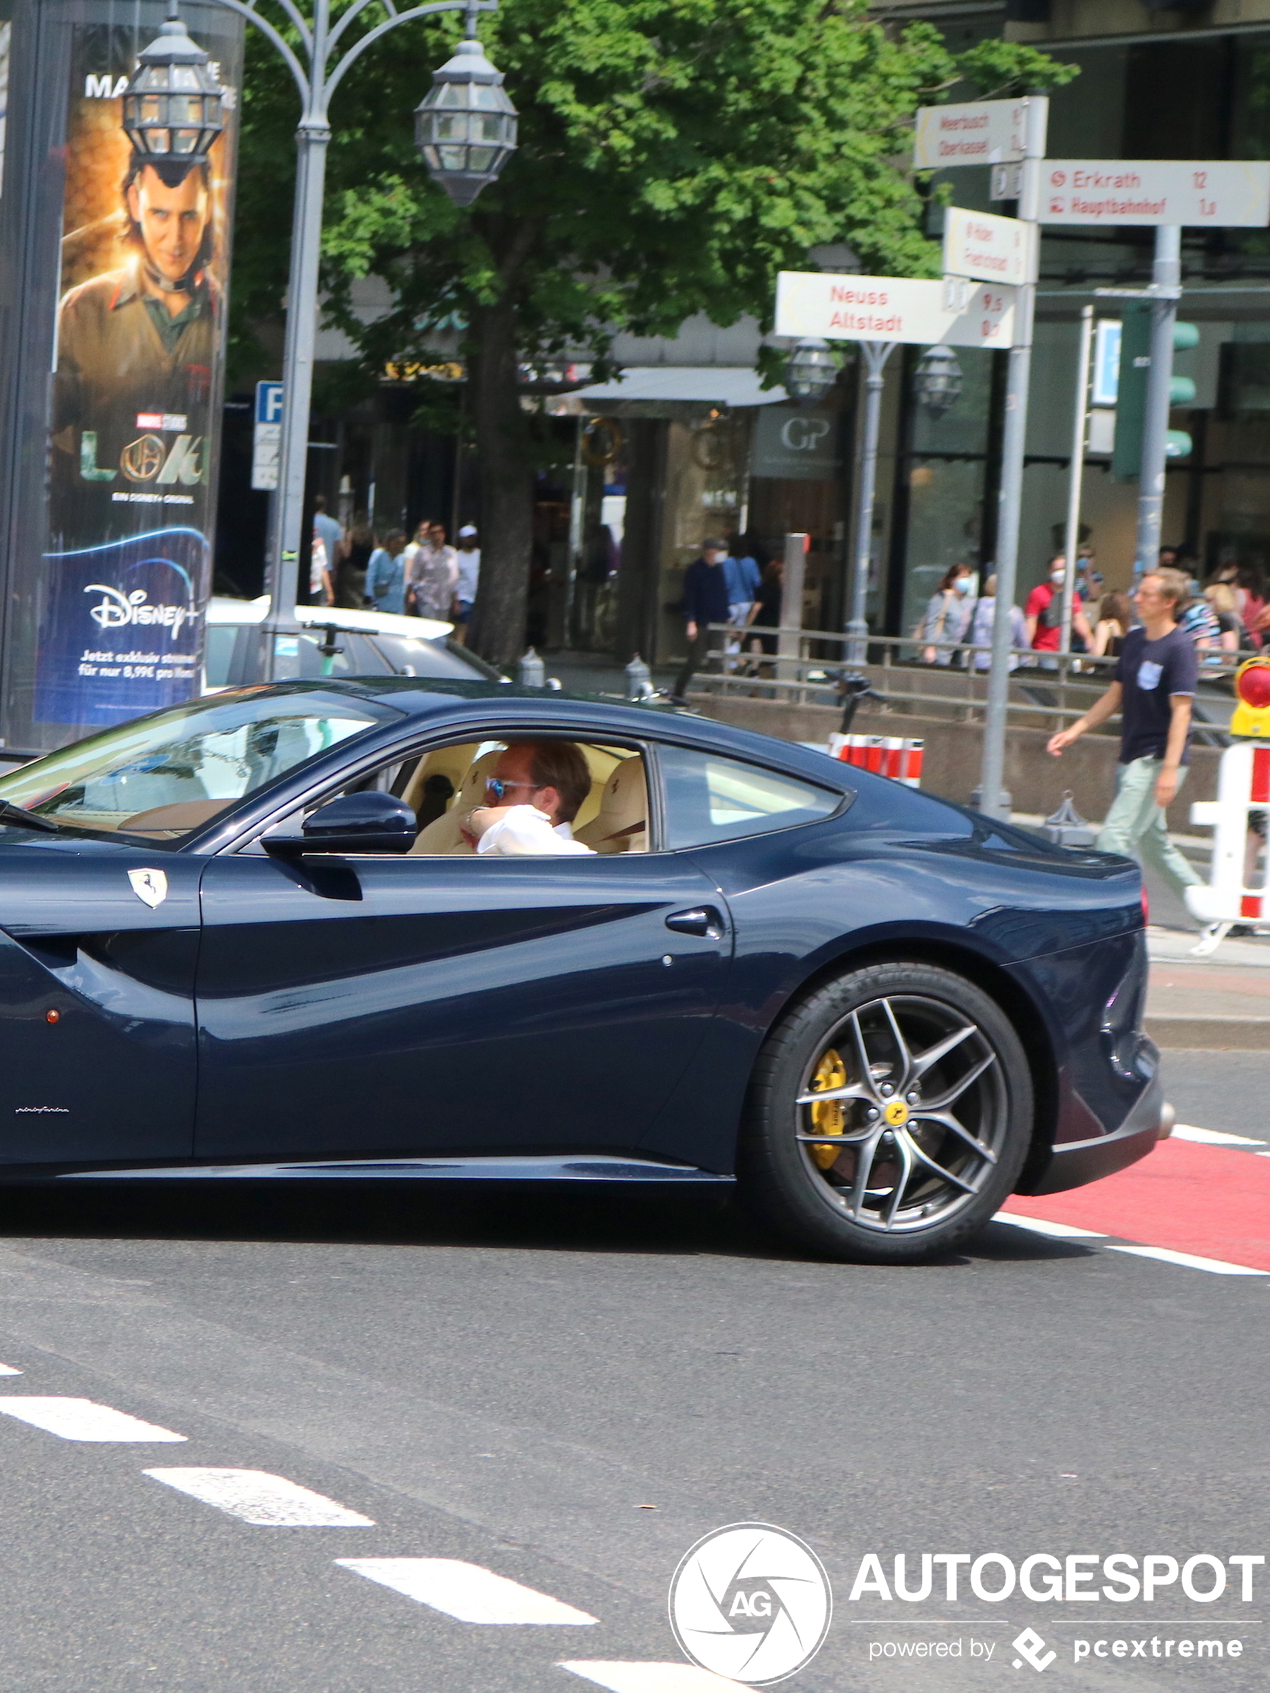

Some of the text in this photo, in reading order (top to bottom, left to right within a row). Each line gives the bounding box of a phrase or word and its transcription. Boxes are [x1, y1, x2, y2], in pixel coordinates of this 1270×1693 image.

[939, 138, 988, 156] Oberkassel
[1072, 170, 1141, 189] Erkrath
[1192, 171, 1208, 189] 12
[1071, 197, 1168, 218] Hauptbahnhof
[831, 285, 889, 306] Neuss
[829, 311, 903, 333] Altstadt
[80, 649, 114, 663] Jetzt
[115, 650, 160, 664] exklusiv
[78, 662, 97, 677] für
[99, 667, 122, 678] nur
[155, 669, 173, 682] pro
